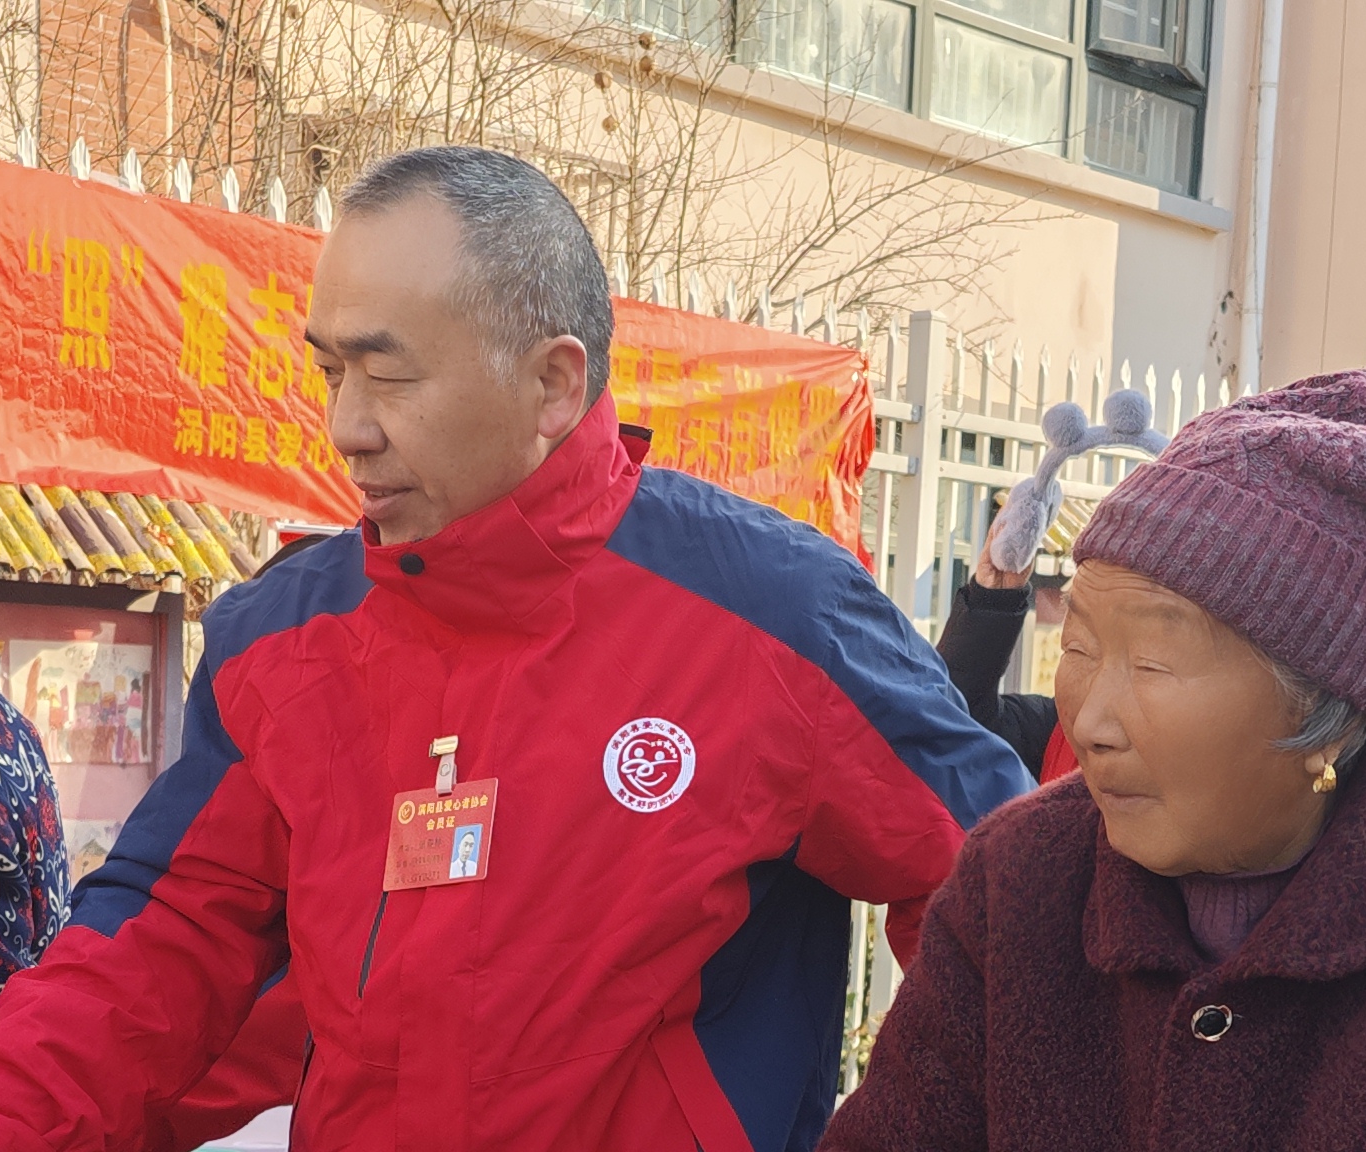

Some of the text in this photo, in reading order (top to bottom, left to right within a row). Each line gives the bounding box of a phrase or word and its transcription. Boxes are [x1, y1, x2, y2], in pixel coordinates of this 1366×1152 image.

[174, 406, 350, 477] 涡阳县爱心
